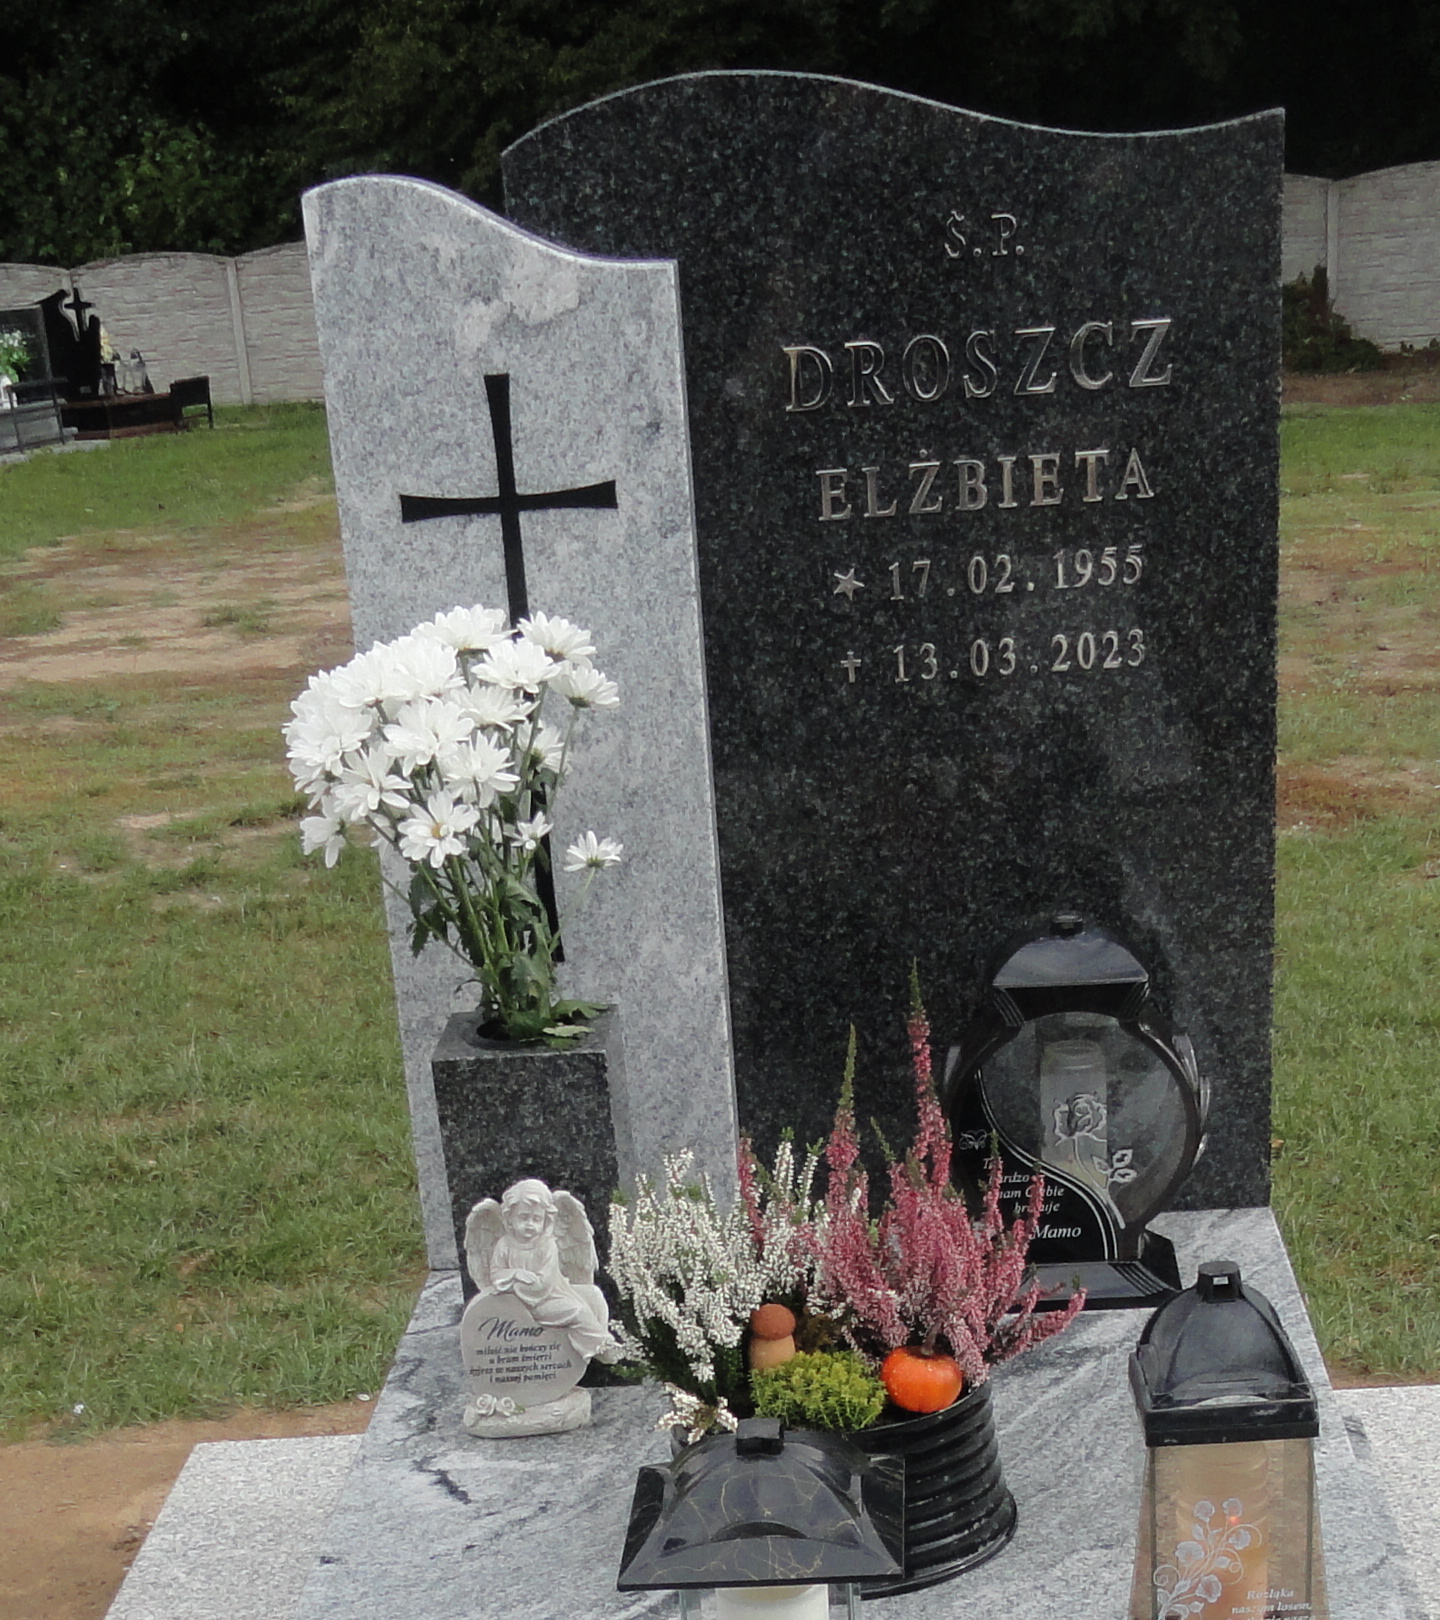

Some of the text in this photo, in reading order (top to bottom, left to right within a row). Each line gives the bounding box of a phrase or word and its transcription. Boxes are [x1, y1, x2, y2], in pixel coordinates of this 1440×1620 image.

[782, 318, 1174, 413] DROSZCZ
[816, 447, 1155, 522] ELŻBIETA
[1029, 1224, 1082, 1240] Mamo
[478, 1317, 544, 1342] Mamo
